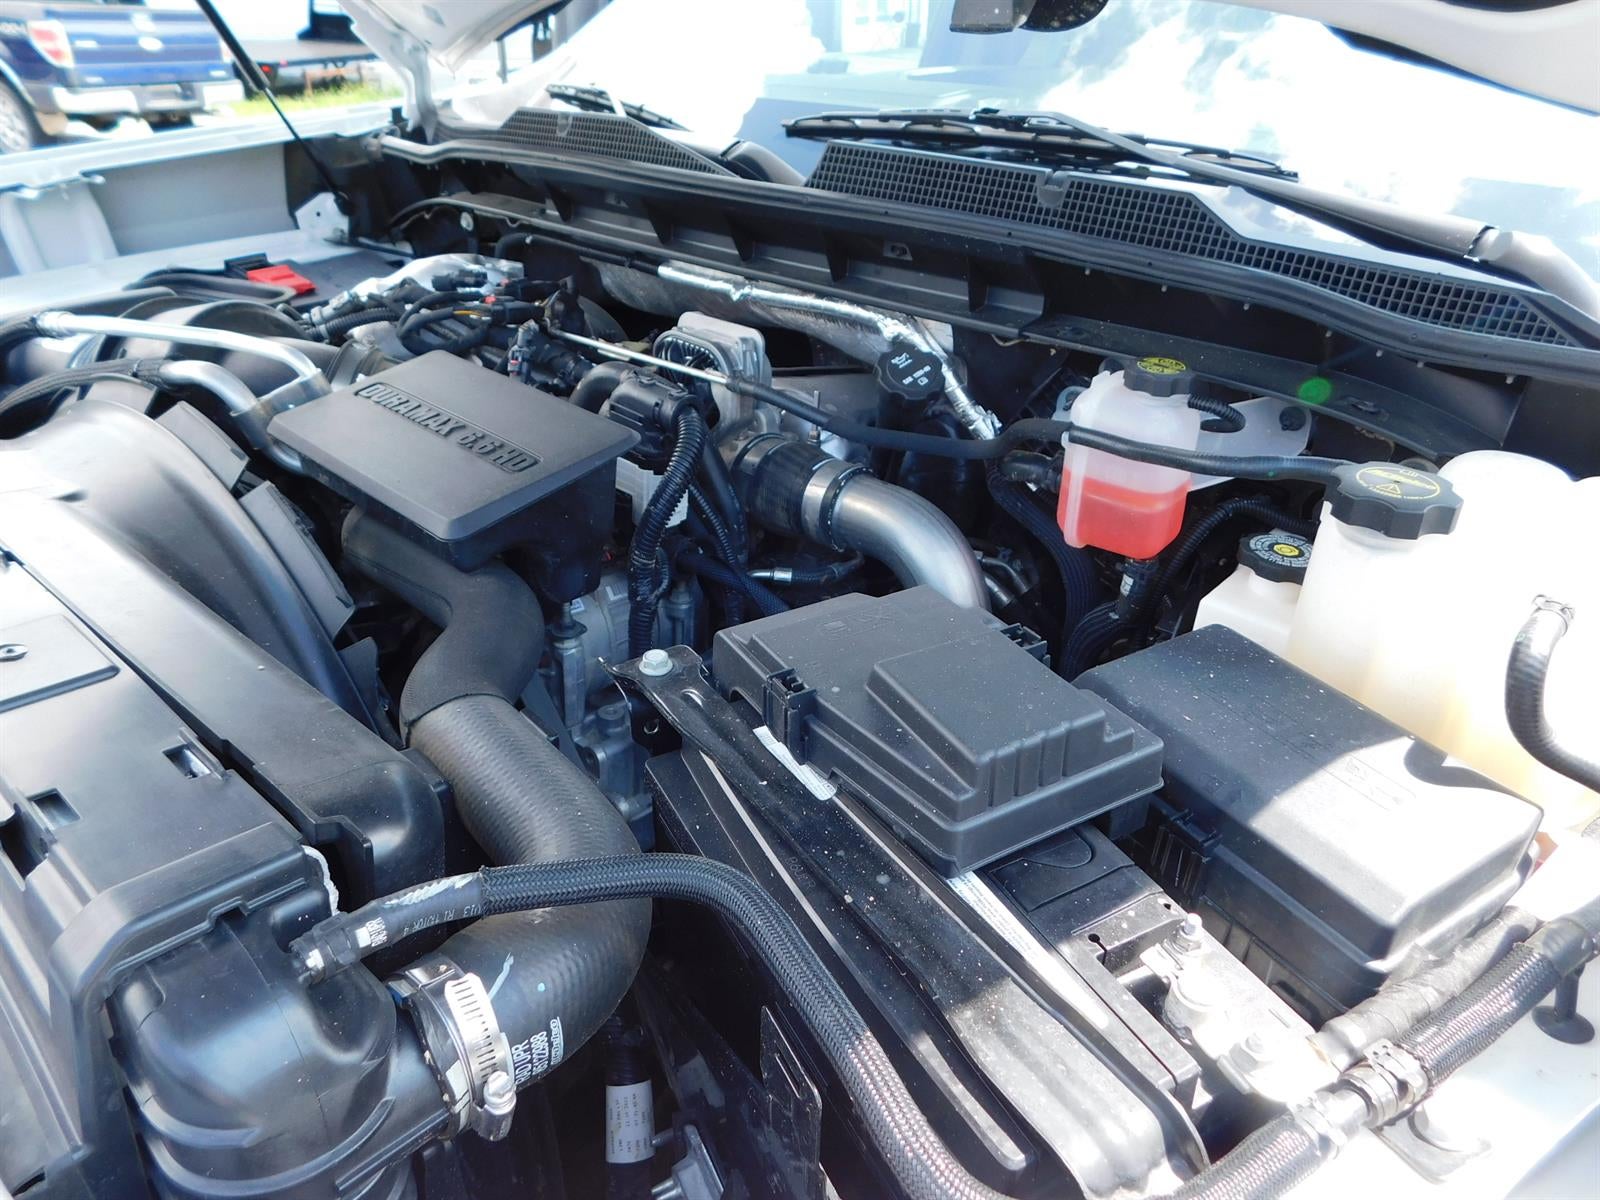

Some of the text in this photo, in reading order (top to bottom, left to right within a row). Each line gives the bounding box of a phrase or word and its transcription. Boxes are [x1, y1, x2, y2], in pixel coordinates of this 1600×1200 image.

[359, 383, 539, 472] DURAMAX 6.6 HD
[511, 1039, 531, 1066] UPR
